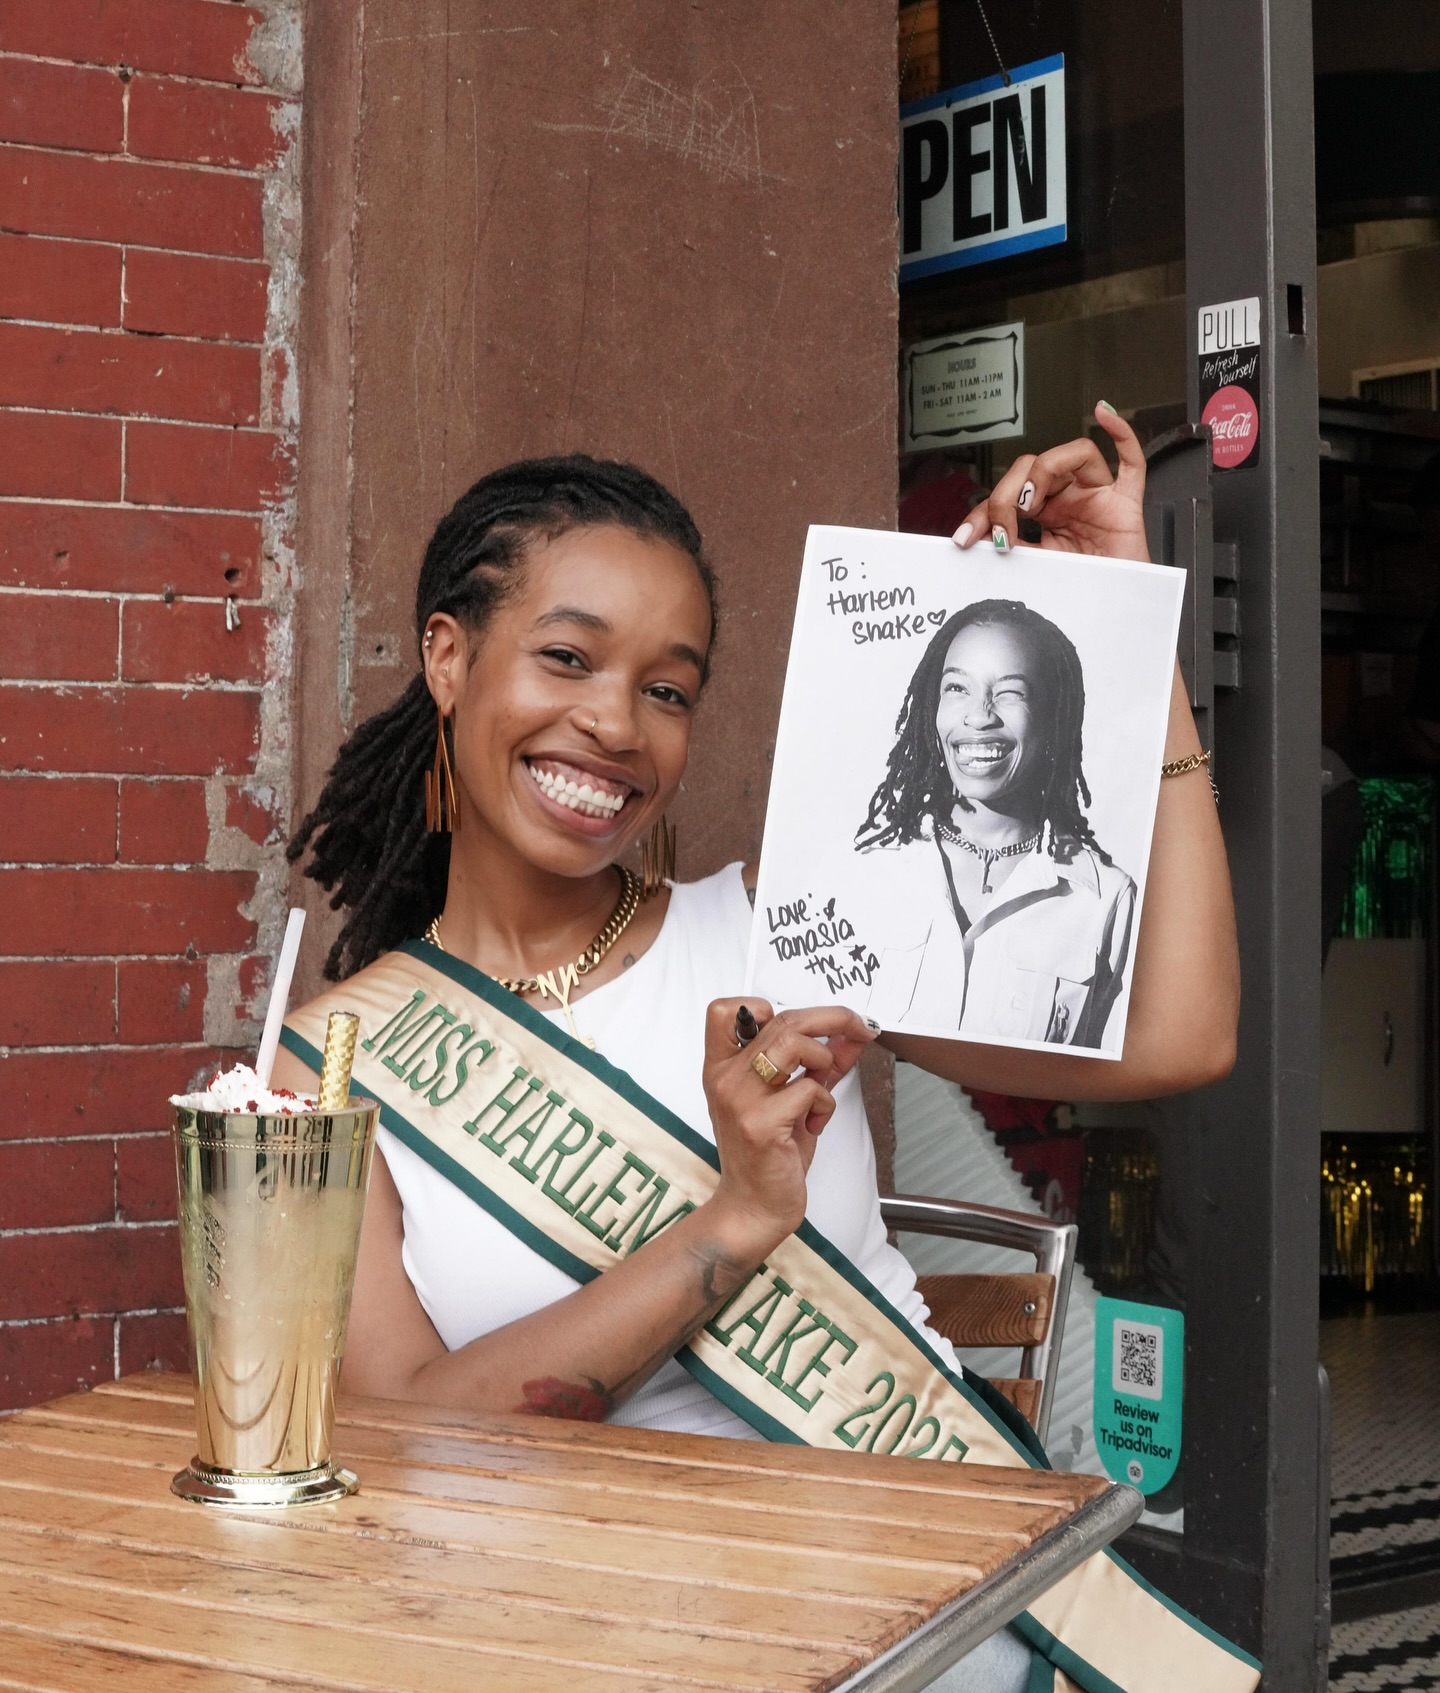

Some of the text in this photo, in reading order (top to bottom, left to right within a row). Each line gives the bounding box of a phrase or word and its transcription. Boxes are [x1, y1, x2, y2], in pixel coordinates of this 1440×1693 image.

[903, 84, 1047, 255] PEN
[1203, 306, 1255, 351] PULL
[1202, 350, 1239, 379] Refresh
[1218, 354, 1258, 387] Yourself
[1222, 443, 1244, 454] BOTTLES
[827, 586, 915, 616] Harlem
[826, 952, 881, 995] Ninja
[360, 989, 497, 1107] MISS
[703, 1262, 859, 1414] AKE
[1114, 1399, 1160, 1424] Review
[1100, 1428, 1173, 1460] Tripadvisor
[1120, 1421, 1153, 1438] us on
